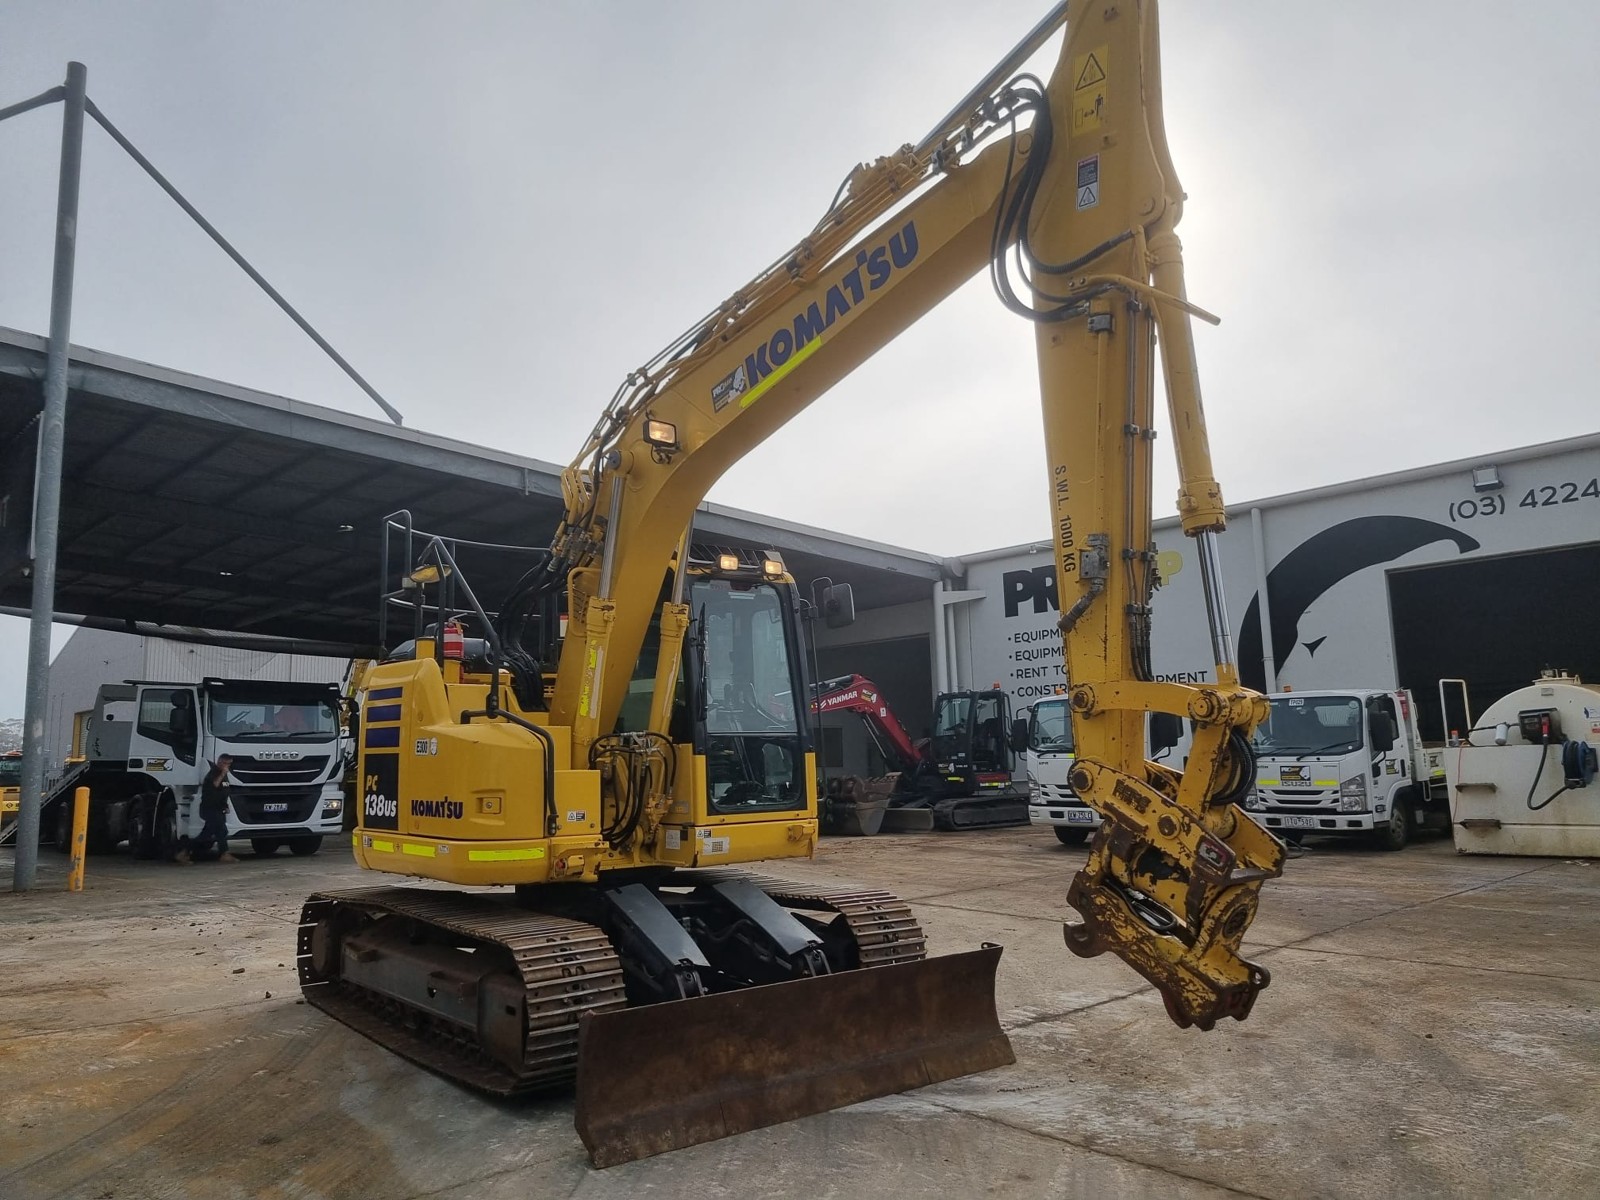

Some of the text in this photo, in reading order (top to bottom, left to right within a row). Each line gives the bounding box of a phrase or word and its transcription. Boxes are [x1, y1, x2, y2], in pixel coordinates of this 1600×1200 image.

[745, 219, 919, 388] KOMATSU
[1449, 478, 1600, 522] (03) 4224
[1055, 465, 1077, 573] S.W.L. 1000 KG
[1014, 628, 1063, 643] EQUIPM
[1015, 646, 1066, 661] EQUIPME
[1016, 667, 1048, 679] RENT
[1017, 683, 1067, 697] CONSTR
[827, 691, 857, 705] YANMAR
[259, 751, 299, 760] IVECO
[366, 775, 378, 791] PC
[411, 796, 463, 819] KOMATSU
